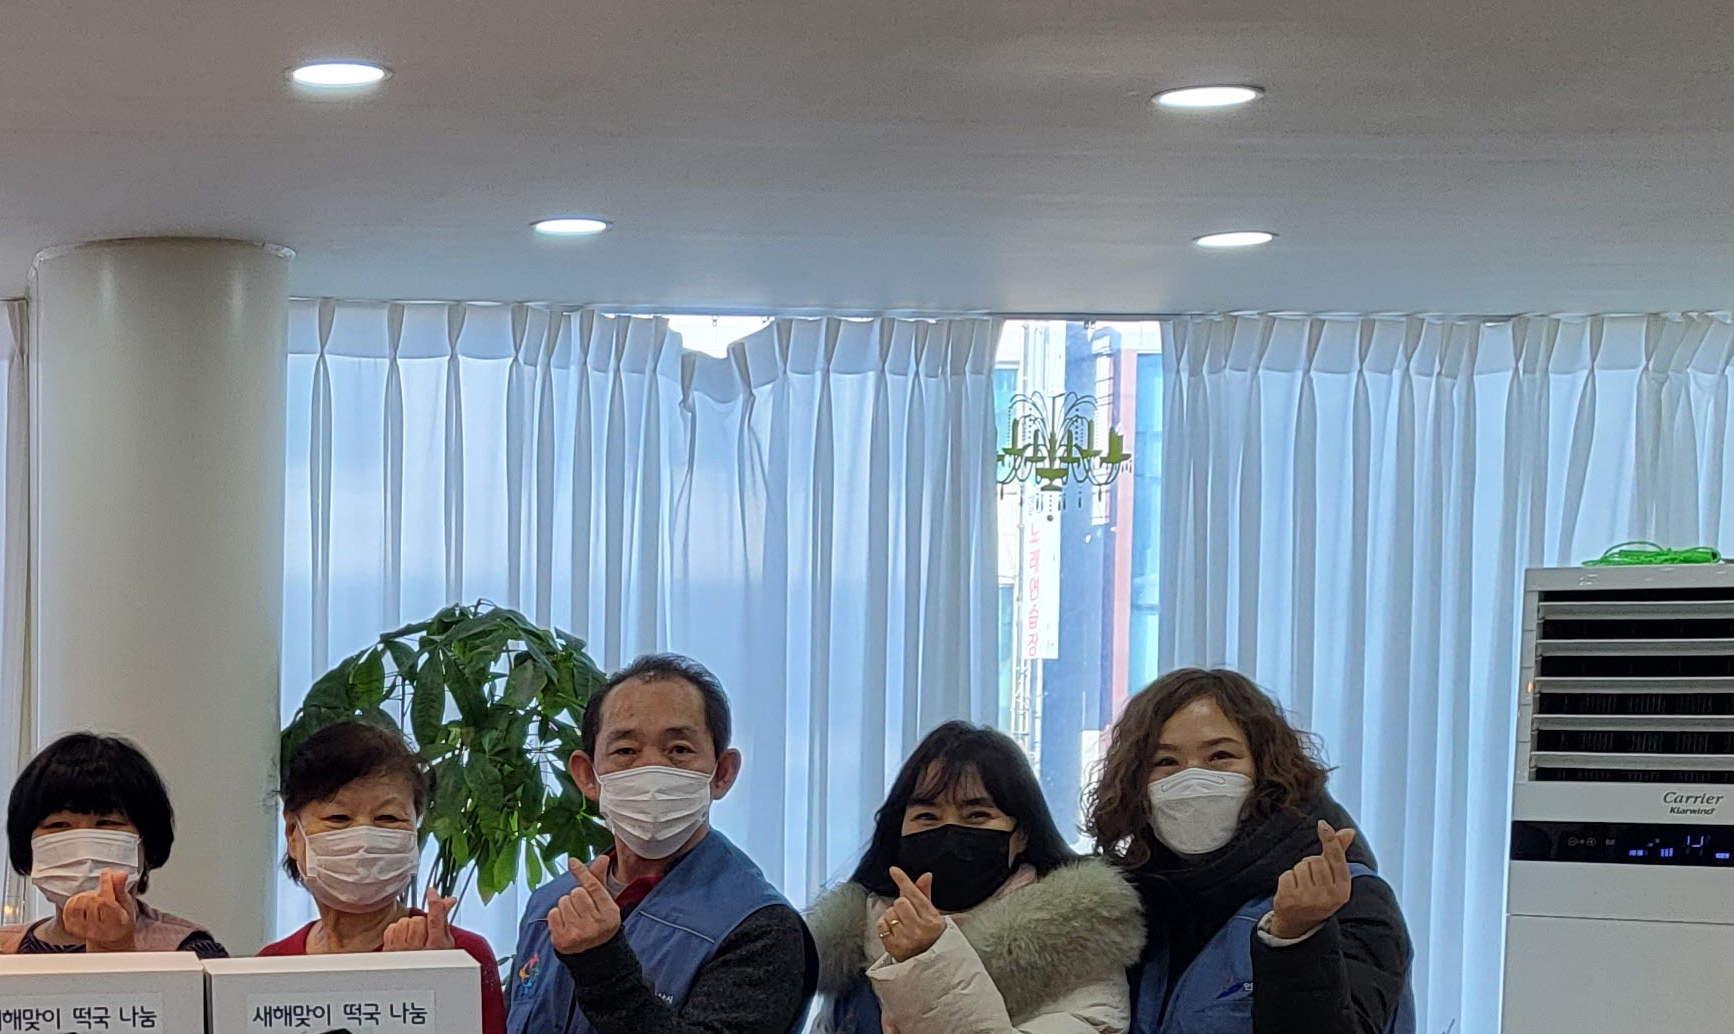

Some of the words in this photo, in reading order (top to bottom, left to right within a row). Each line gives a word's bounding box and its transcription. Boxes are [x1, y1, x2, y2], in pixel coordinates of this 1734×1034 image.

[1663, 791, 1724, 805] Carrier
[73, 1007, 112, 1030] 떡국
[119, 1006, 158, 1029] 나눔
[252, 1004, 332, 1028] 새해맞이
[343, 1003, 382, 1027] 떡국
[390, 1002, 429, 1025] 나눔
